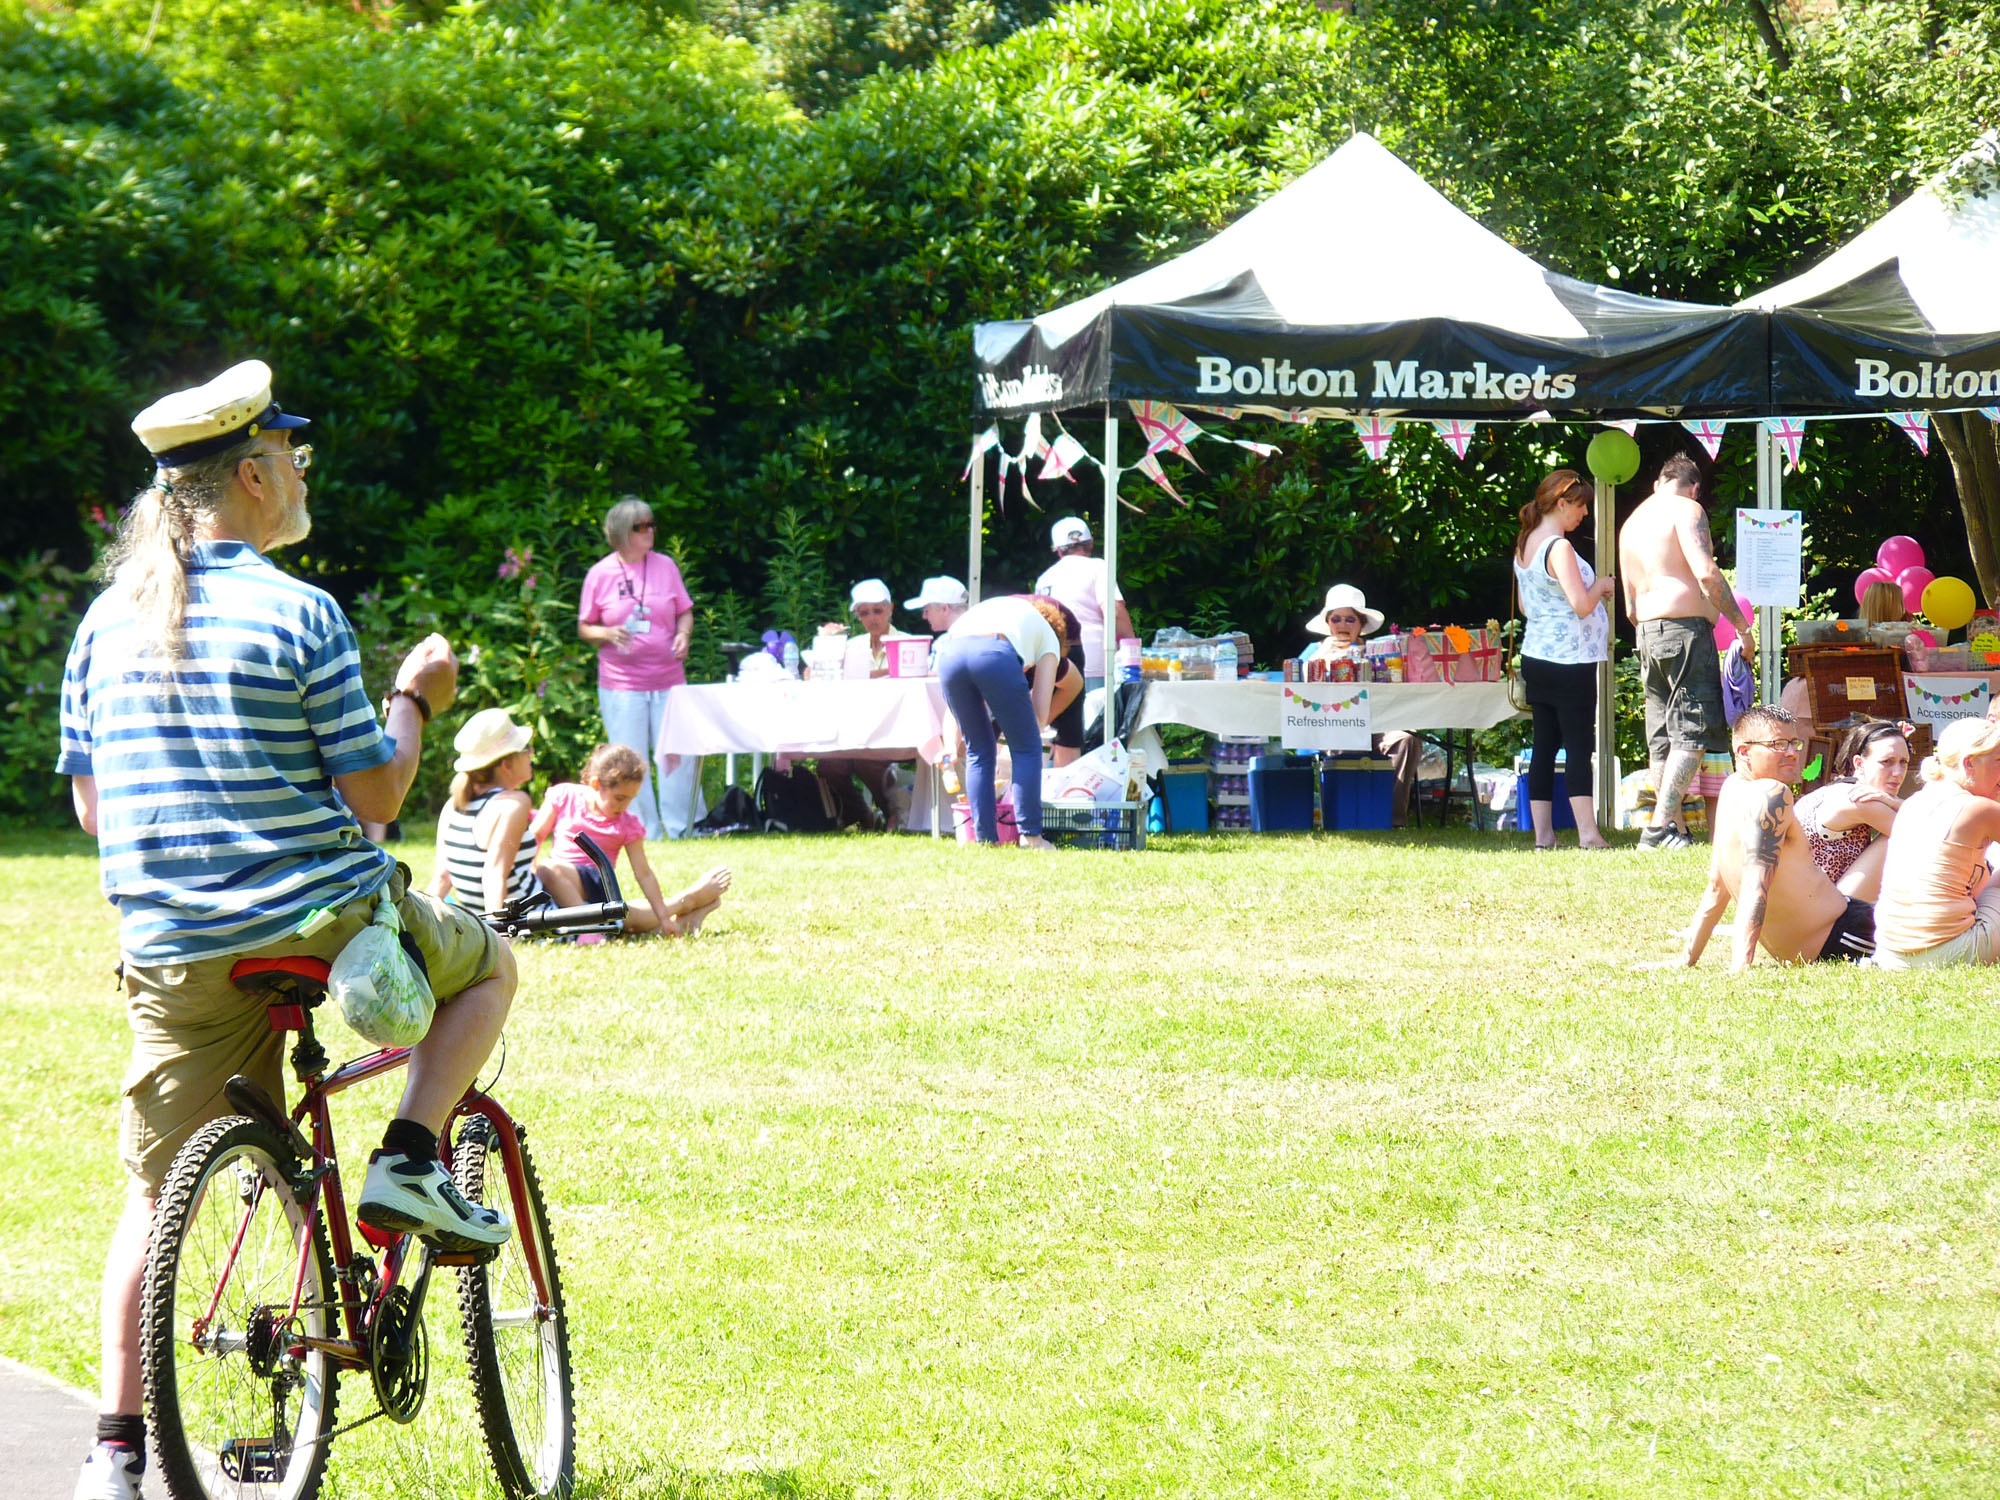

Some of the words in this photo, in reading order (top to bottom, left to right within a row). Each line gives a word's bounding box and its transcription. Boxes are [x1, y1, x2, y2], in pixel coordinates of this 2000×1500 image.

[1196, 356, 1358, 396] Bolton
[1371, 360, 1577, 401] Markets
[1917, 706, 1980, 720] Accessories
[1287, 715, 1366, 728] Refreshments
